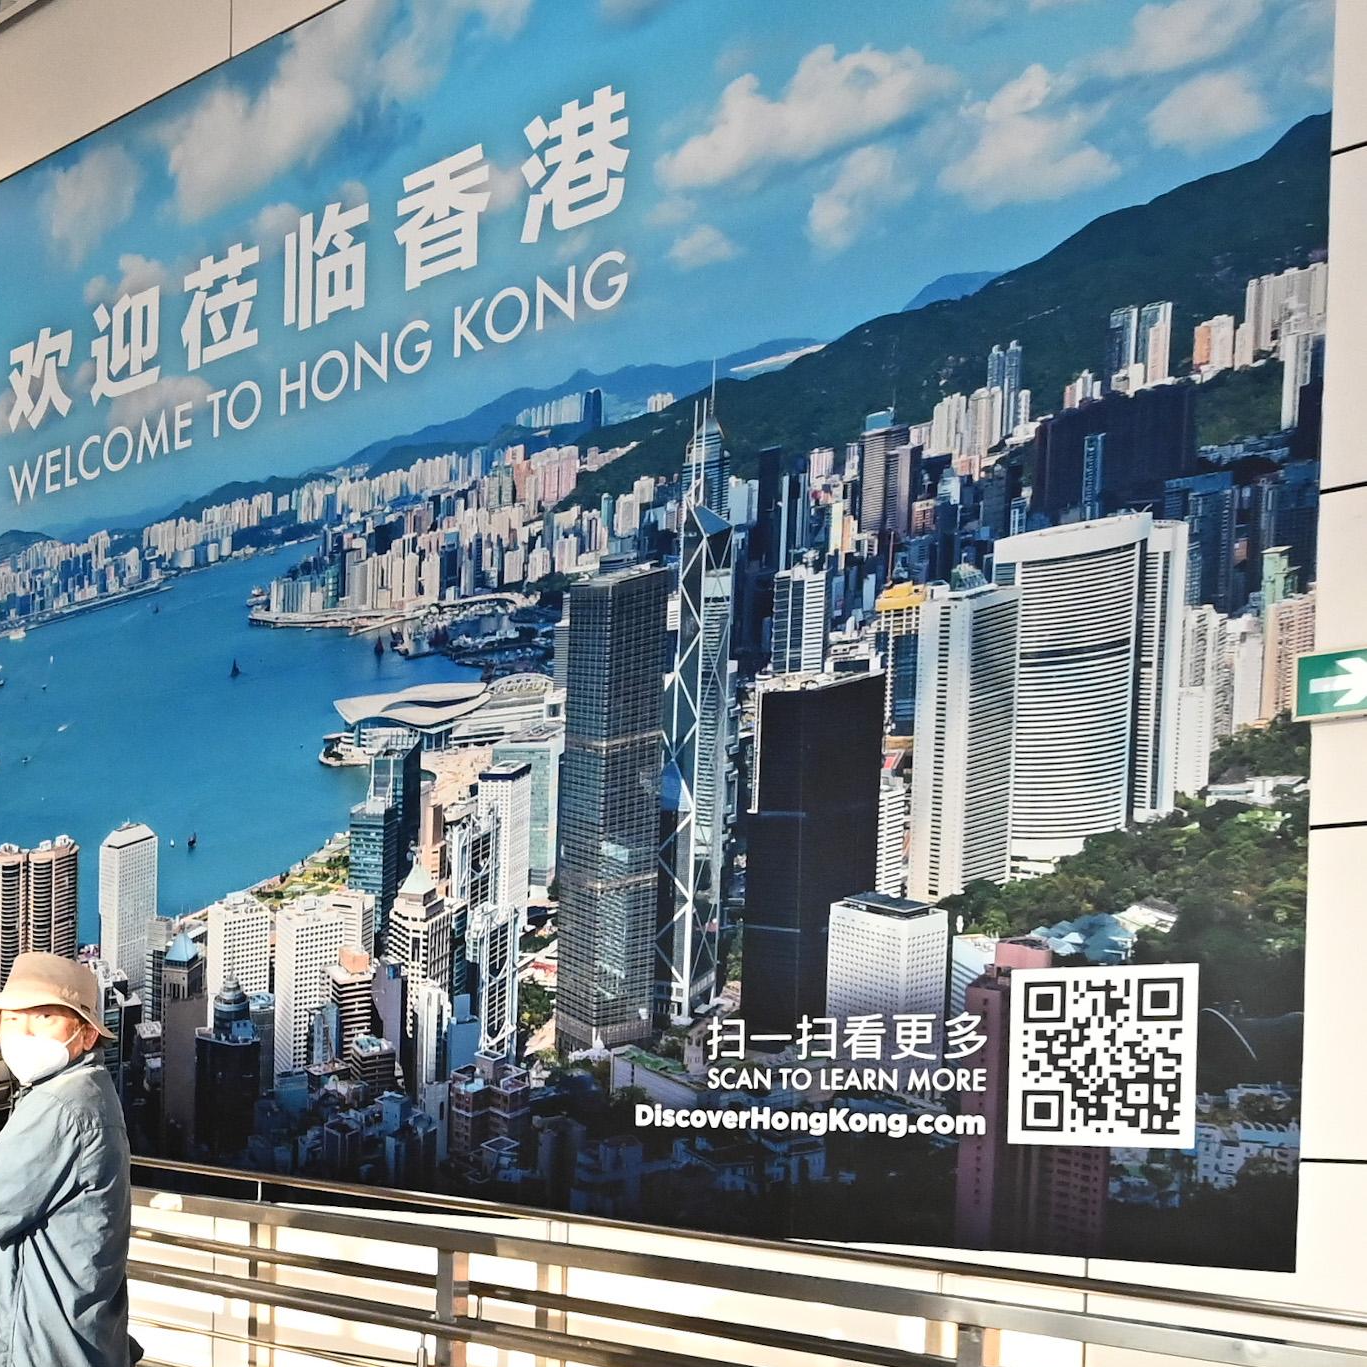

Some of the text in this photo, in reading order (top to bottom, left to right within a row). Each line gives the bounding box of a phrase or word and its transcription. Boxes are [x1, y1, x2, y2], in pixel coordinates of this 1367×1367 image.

[9, 85, 629, 433] 欢迎莅临香港
[8, 250, 629, 505] WELCOME TO HONG KONG
[706, 1011, 989, 1061] 扫一扫看更多
[707, 1067, 987, 1092] SCAN TO LEARN MORE
[635, 1103, 986, 1138] DiscoverHongKong.com
